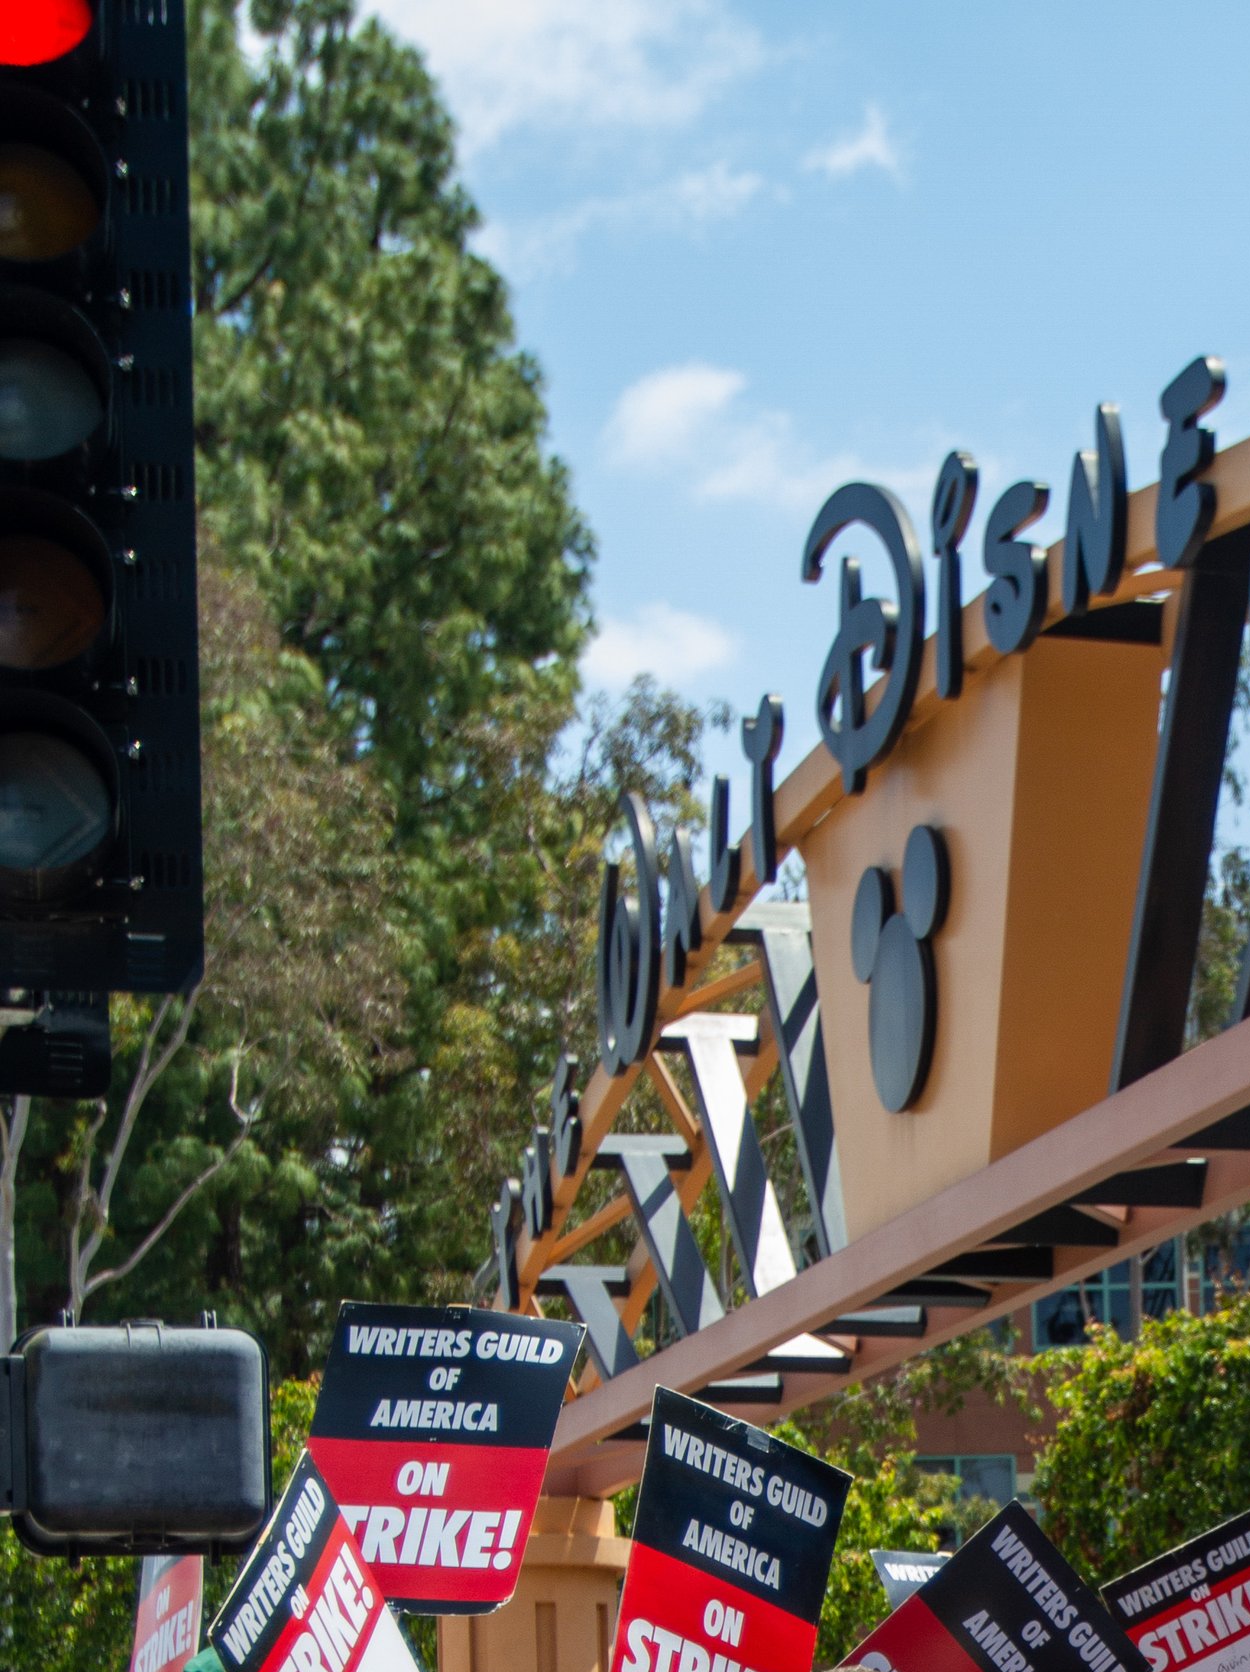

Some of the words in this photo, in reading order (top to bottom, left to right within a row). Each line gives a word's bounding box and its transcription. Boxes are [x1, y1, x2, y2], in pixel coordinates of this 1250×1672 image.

[348, 1325, 472, 1358] WRITERS
[475, 1331, 564, 1365] GUILD
[429, 1366, 462, 1392] OF
[369, 1398, 499, 1433] AMERICA
[396, 1460, 451, 1497] ON
[663, 1423, 765, 1498] WRITERS
[766, 1475, 829, 1528] GUILD
[729, 1500, 755, 1531] OF
[338, 1503, 523, 1571] TRIKE!
[682, 1517, 780, 1591] AMERICA
[222, 1539, 297, 1666] WRITERS
[285, 1476, 326, 1561] GUILD
[990, 1524, 1079, 1630] WRITERS
[1117, 1557, 1208, 1618] WRITERS
[290, 1583, 311, 1620] ON
[1190, 1582, 1212, 1604] ON
[703, 1598, 745, 1648] ON
[1021, 1619, 1051, 1650] OF
